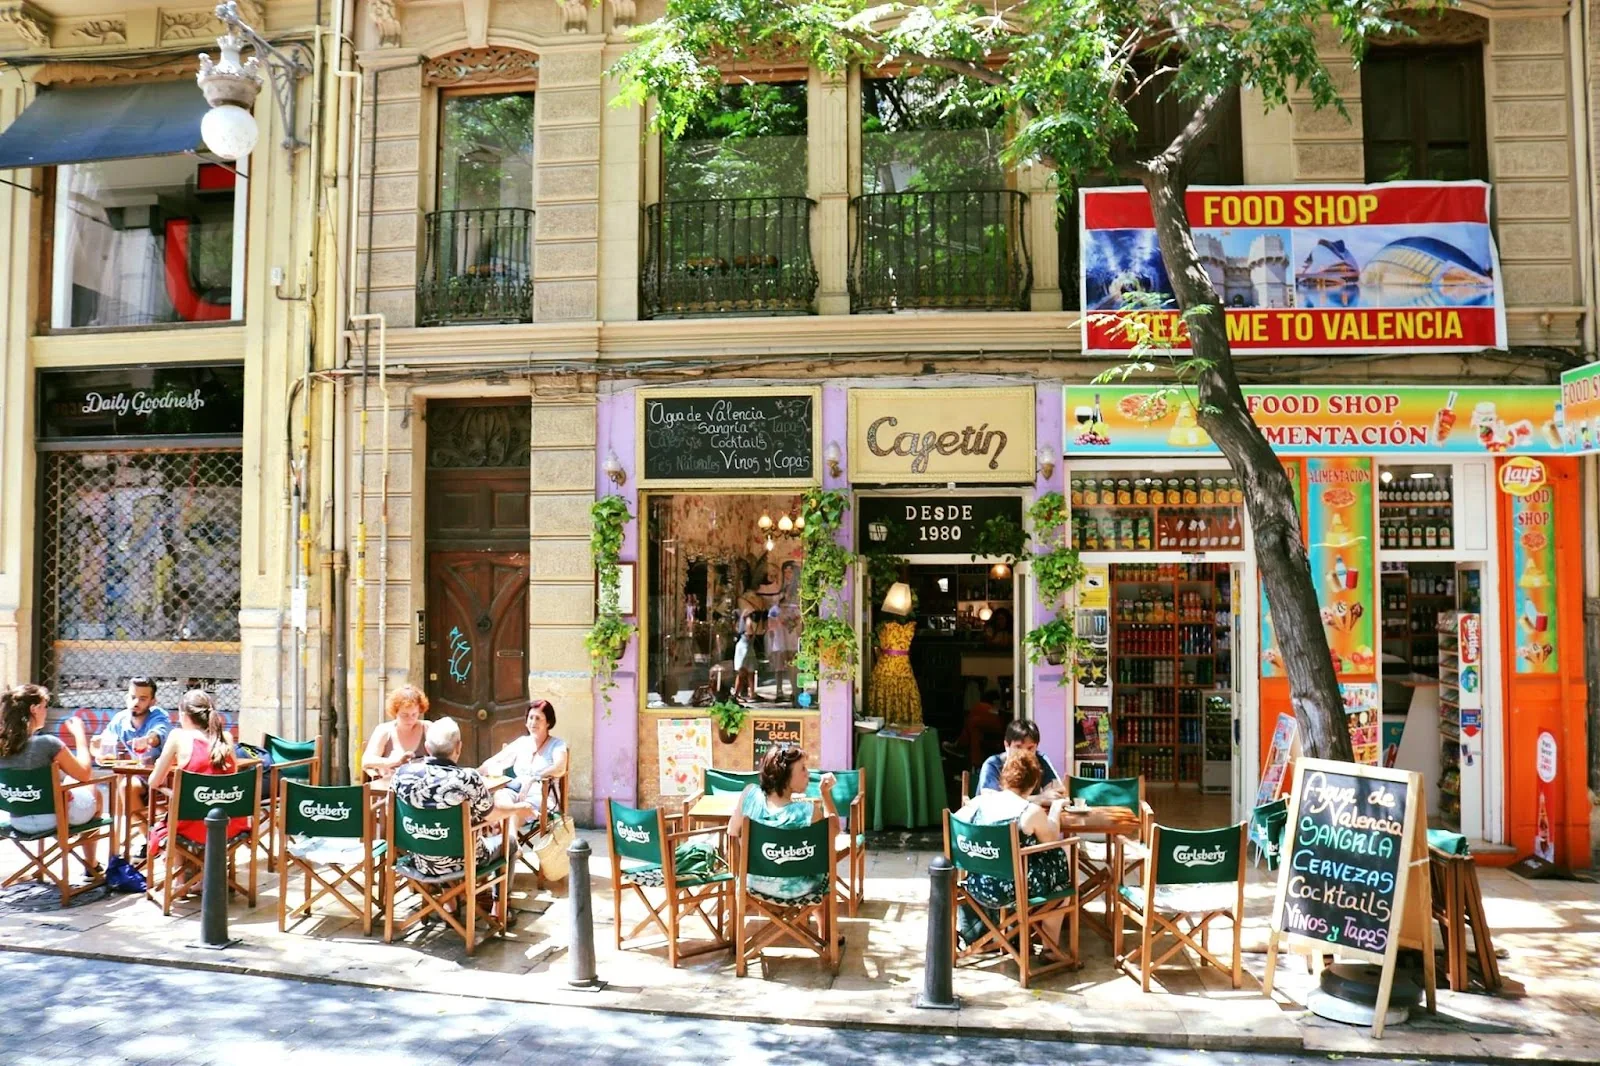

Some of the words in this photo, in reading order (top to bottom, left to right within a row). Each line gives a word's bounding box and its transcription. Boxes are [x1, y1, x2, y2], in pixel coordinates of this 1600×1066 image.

[1203, 195, 1284, 226] FOOD
[1294, 193, 1378, 225] SHOP
[1124, 312, 1269, 343] WELME
[1282, 312, 1314, 341] TO
[1323, 310, 1464, 341] VALENCIA
[82, 392, 130, 416] Daily
[132, 389, 204, 416] Goodness
[1564, 379, 1589, 406] FOOD
[650, 402, 685, 428] Agua
[686, 405, 702, 422] de
[706, 400, 766, 422] Valencia
[1247, 396, 1320, 414] FOOD
[1328, 396, 1400, 414] SHOP
[710, 435, 768, 451] Cocktails
[867, 416, 1008, 474] Cafetín
[1256, 421, 1428, 445] MENTACIÓN
[719, 450, 760, 474] Vinos
[764, 455, 773, 471] y
[773, 450, 810, 476] Copas
[905, 505, 973, 521] DESDE
[1518, 512, 1549, 526] SHOP
[919, 525, 962, 541] 1980
[768, 731, 800, 740] BEER
[193, 785, 245, 806] Carlsberg
[1368, 786, 1396, 807] de
[299, 800, 353, 822] Carlsberg
[1326, 799, 1402, 836] Valencia
[402, 815, 451, 841] Carlsberg
[616, 821, 650, 844] Carlsberg
[761, 840, 817, 865] Carlsberg
[956, 834, 1000, 860] Carlsberg
[1172, 844, 1228, 868] Carlsberg
[1287, 876, 1392, 922] Cocktails
[1326, 925, 1339, 942] y
